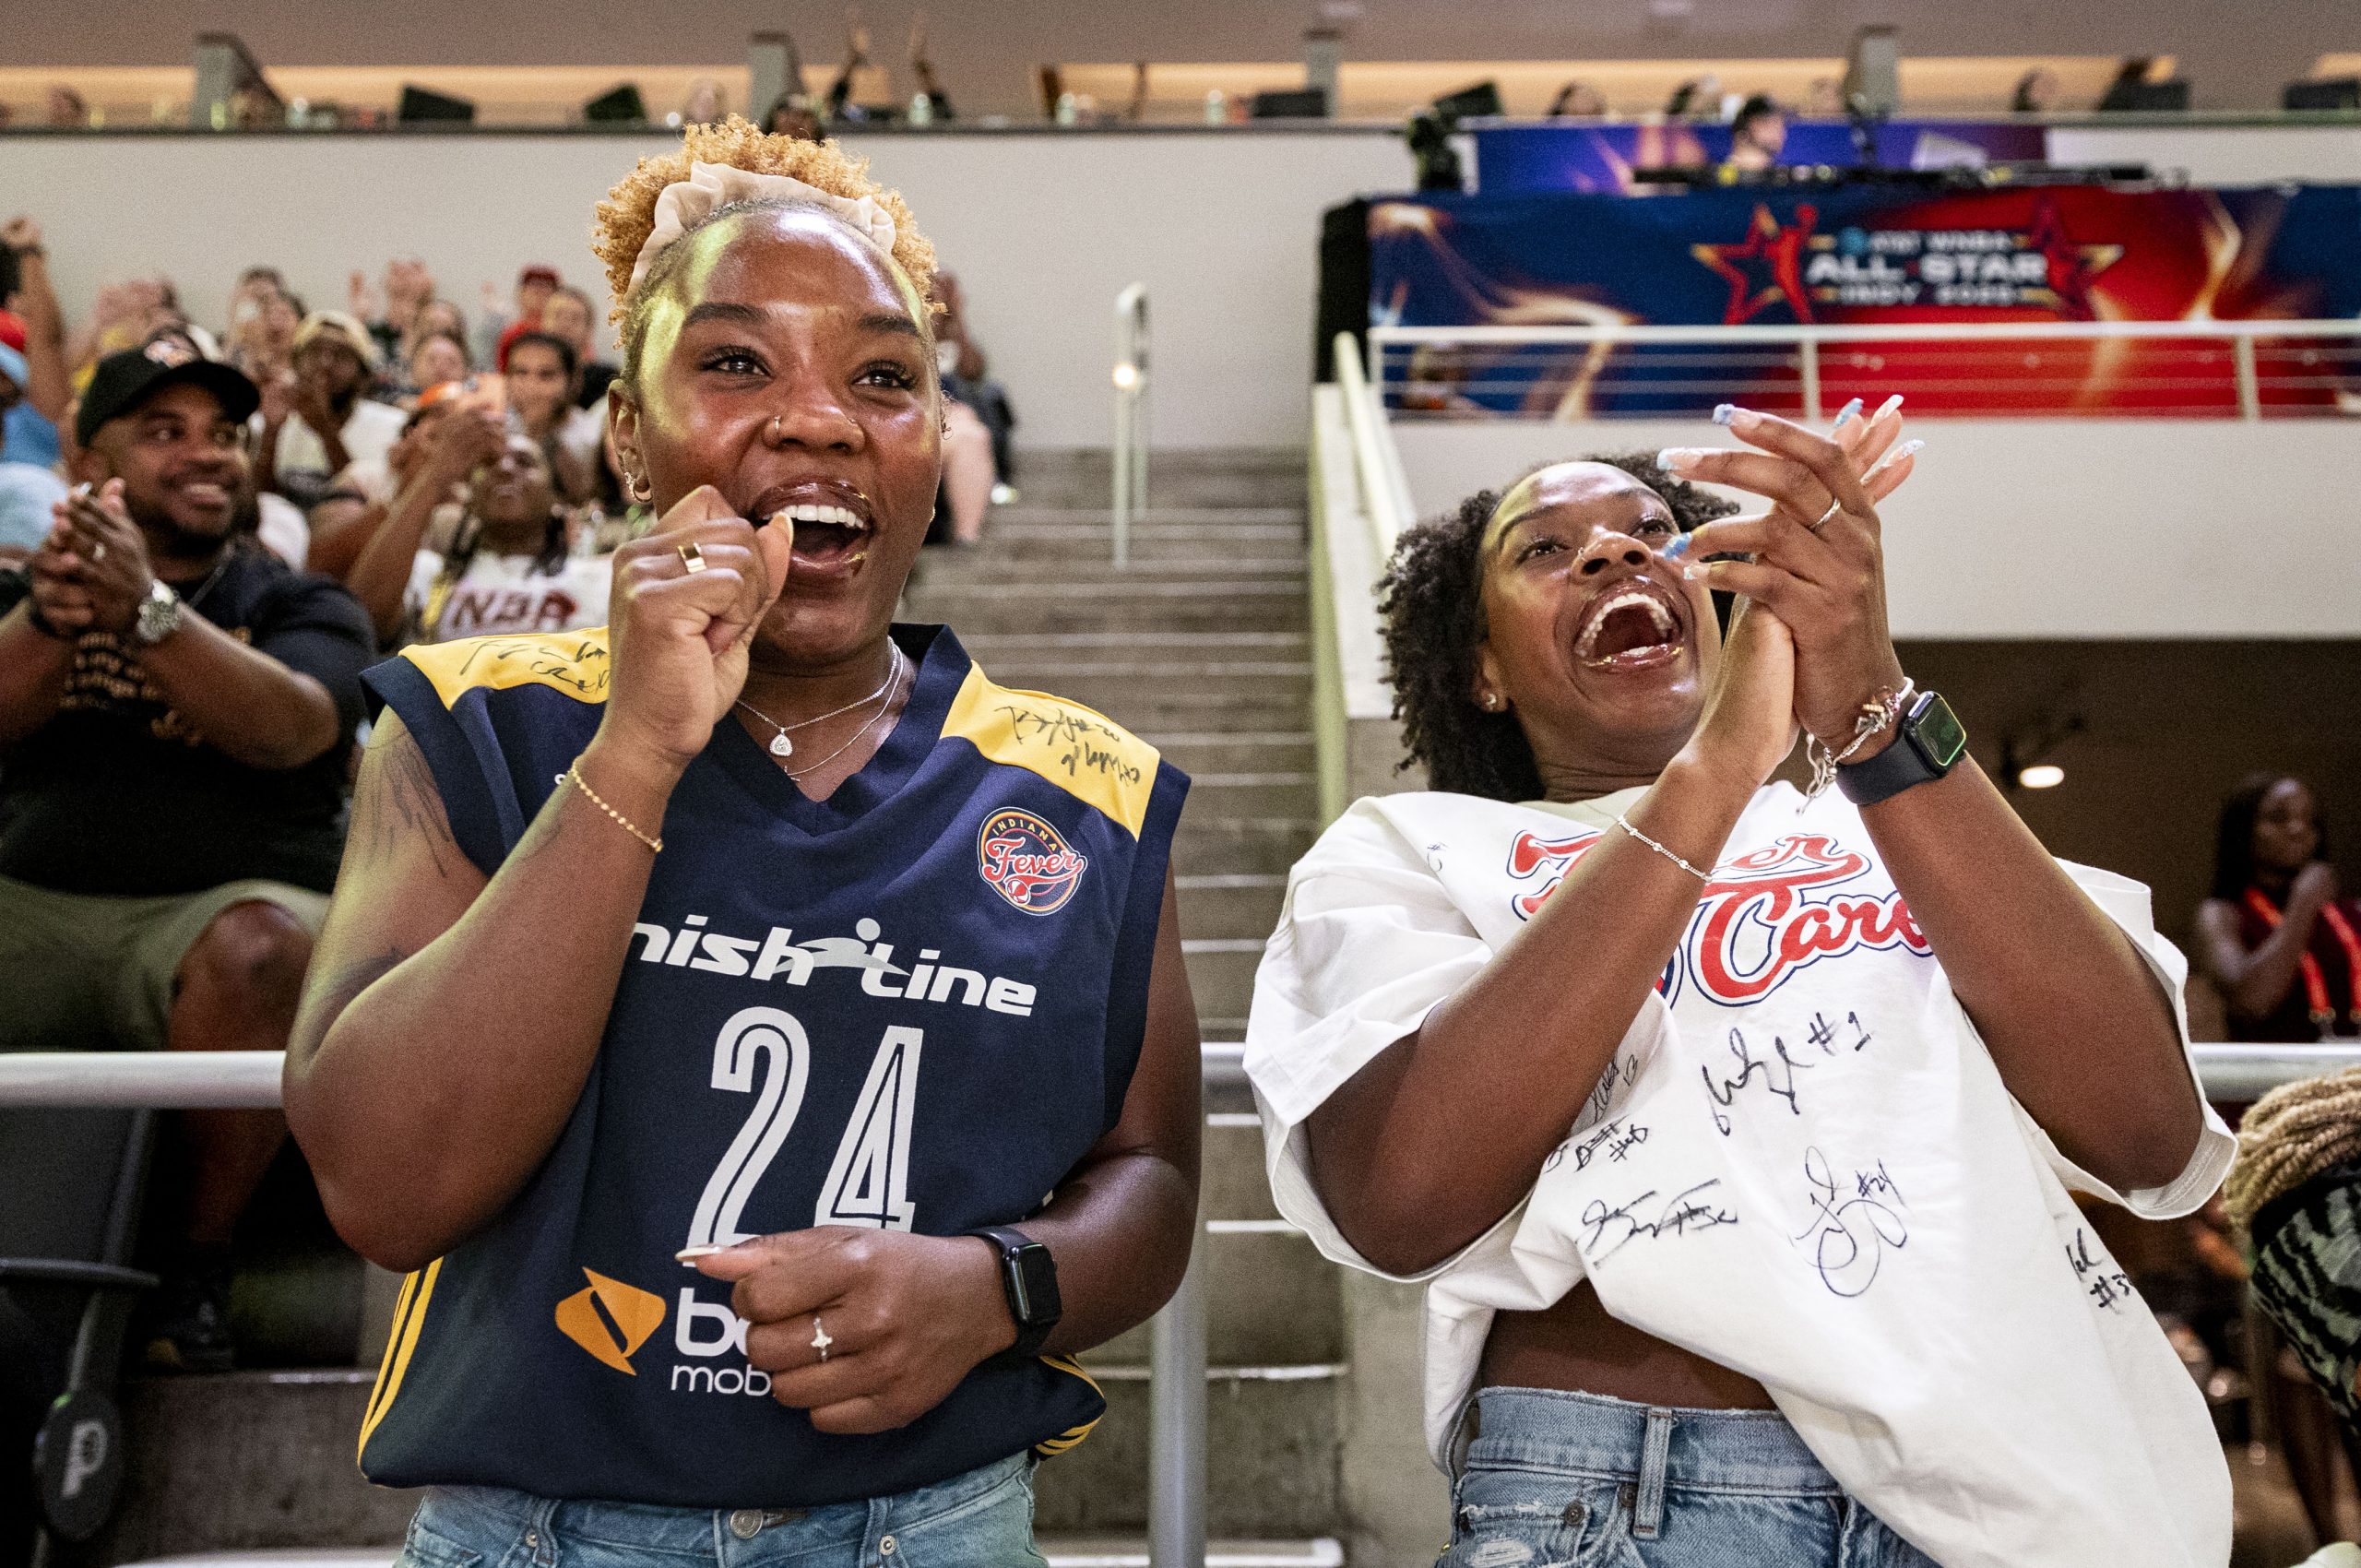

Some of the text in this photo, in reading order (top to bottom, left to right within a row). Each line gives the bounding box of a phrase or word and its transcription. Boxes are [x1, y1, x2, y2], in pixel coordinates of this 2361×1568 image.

[1806, 252, 2048, 284] ALL STAR
[992, 818, 1058, 851] INDIANA
[981, 836, 1085, 884] Fever
[634, 914, 815, 987] nish
[682, 1005, 925, 1266] 24
[670, 1364, 772, 1396] mob
